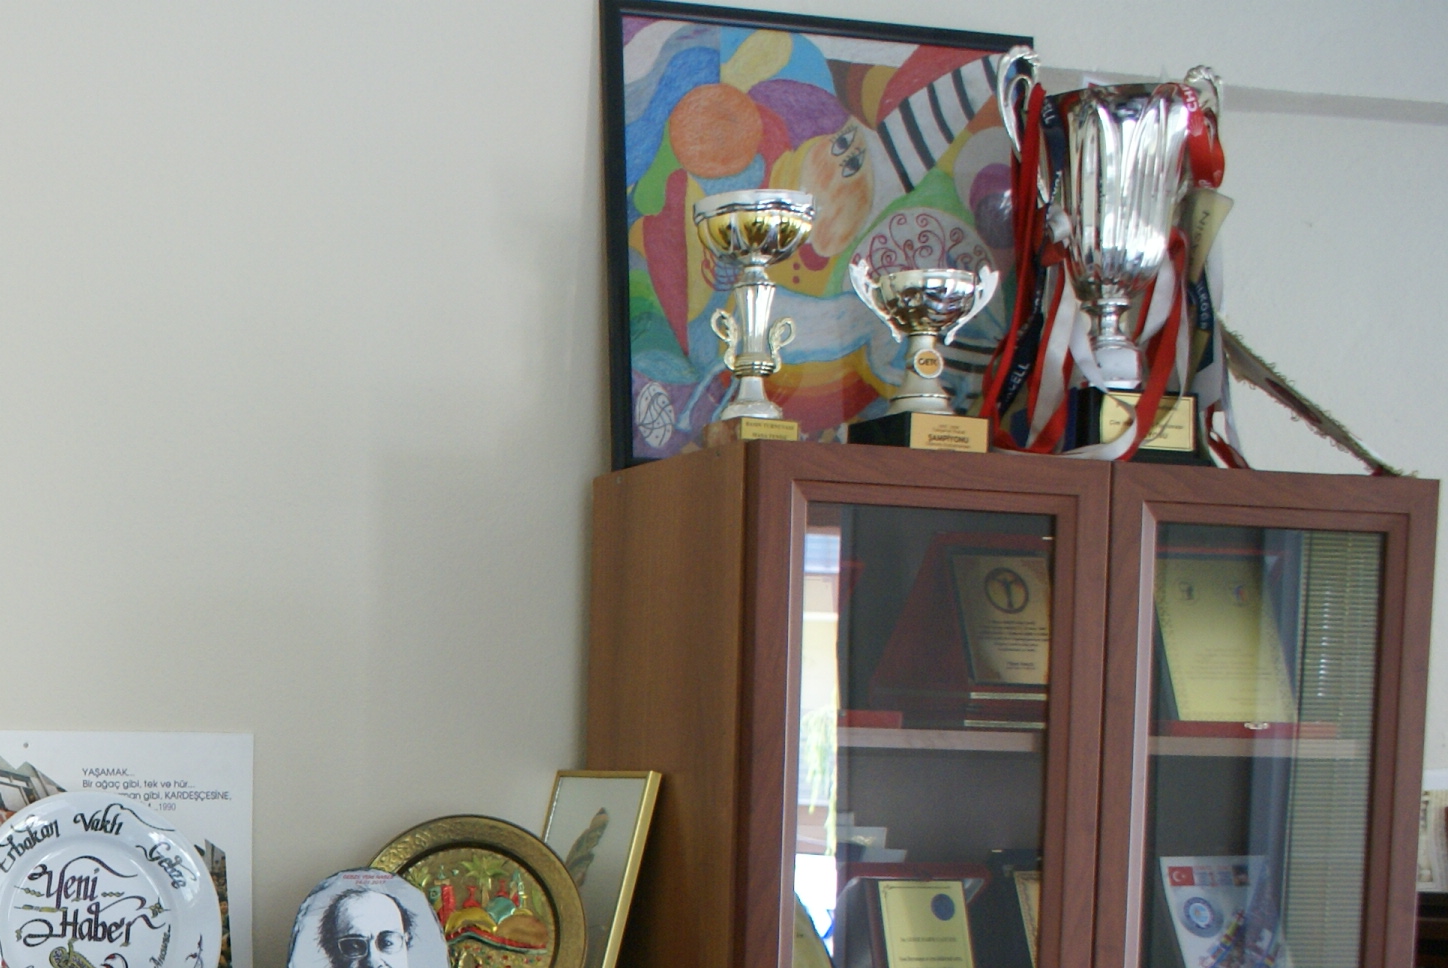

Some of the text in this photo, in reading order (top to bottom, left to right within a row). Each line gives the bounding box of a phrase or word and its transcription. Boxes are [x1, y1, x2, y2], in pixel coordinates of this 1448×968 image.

[82, 768, 135, 778] YAŞAMAK...
[82, 780, 94, 788] Bir
[95, 779, 120, 790] ağaç
[123, 779, 142, 790] gibi,
[144, 780, 158, 788] tek
[143, 791, 232, 802] gibi, KARDEŞÇESİNE,
